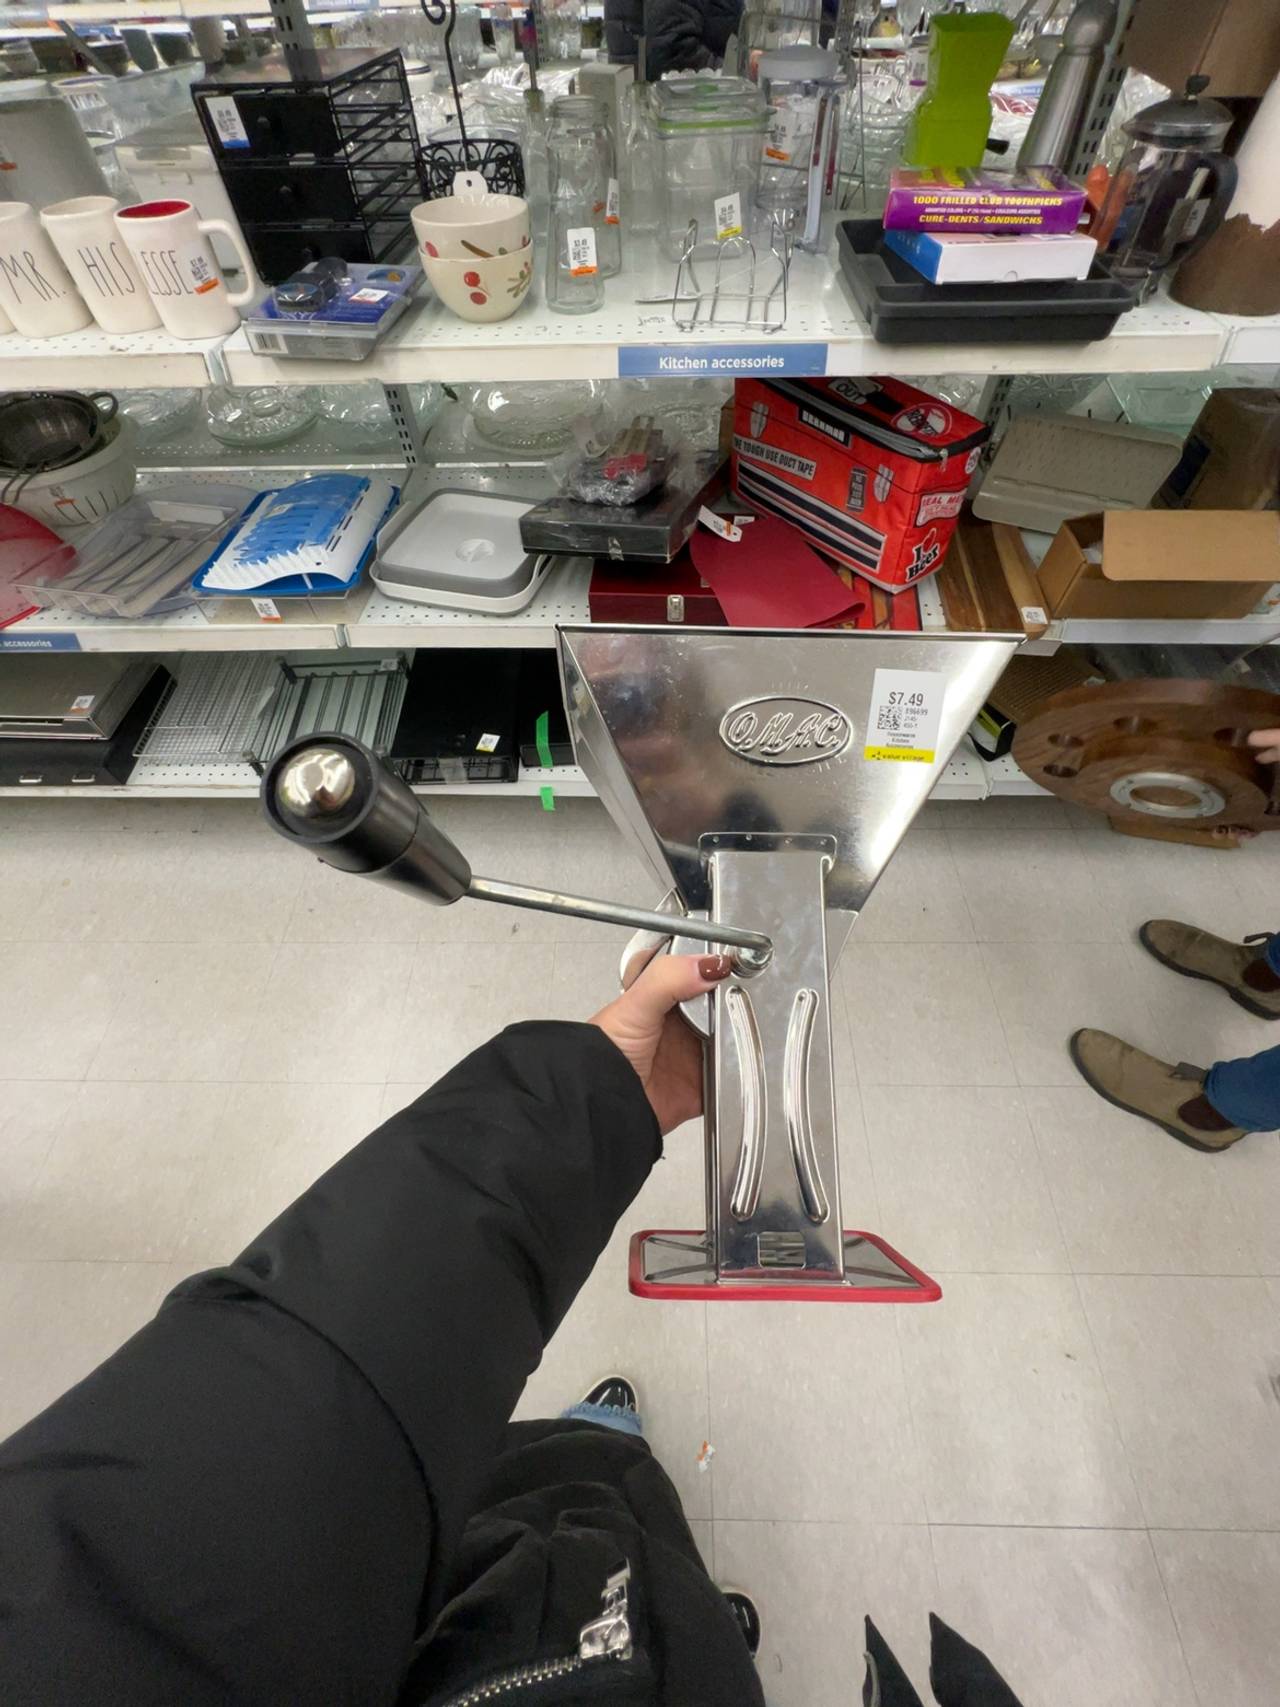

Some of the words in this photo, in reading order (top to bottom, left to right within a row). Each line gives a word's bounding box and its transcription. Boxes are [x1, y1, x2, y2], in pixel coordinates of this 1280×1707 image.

[913, 196, 938, 205] 1000
[940, 196, 977, 205] FRILLED
[978, 196, 1003, 206] CLUB
[1004, 196, 1063, 206] TOOTHPICKS
[0, 251, 67, 304] MR.
[77, 241, 135, 297] HIS
[659, 356, 708, 369] Kitchen
[711, 355, 785, 369] accessories
[779, 454, 797, 469] DUCT
[797, 459, 815, 475] TAPE
[888, 691, 924, 706] $7.49
